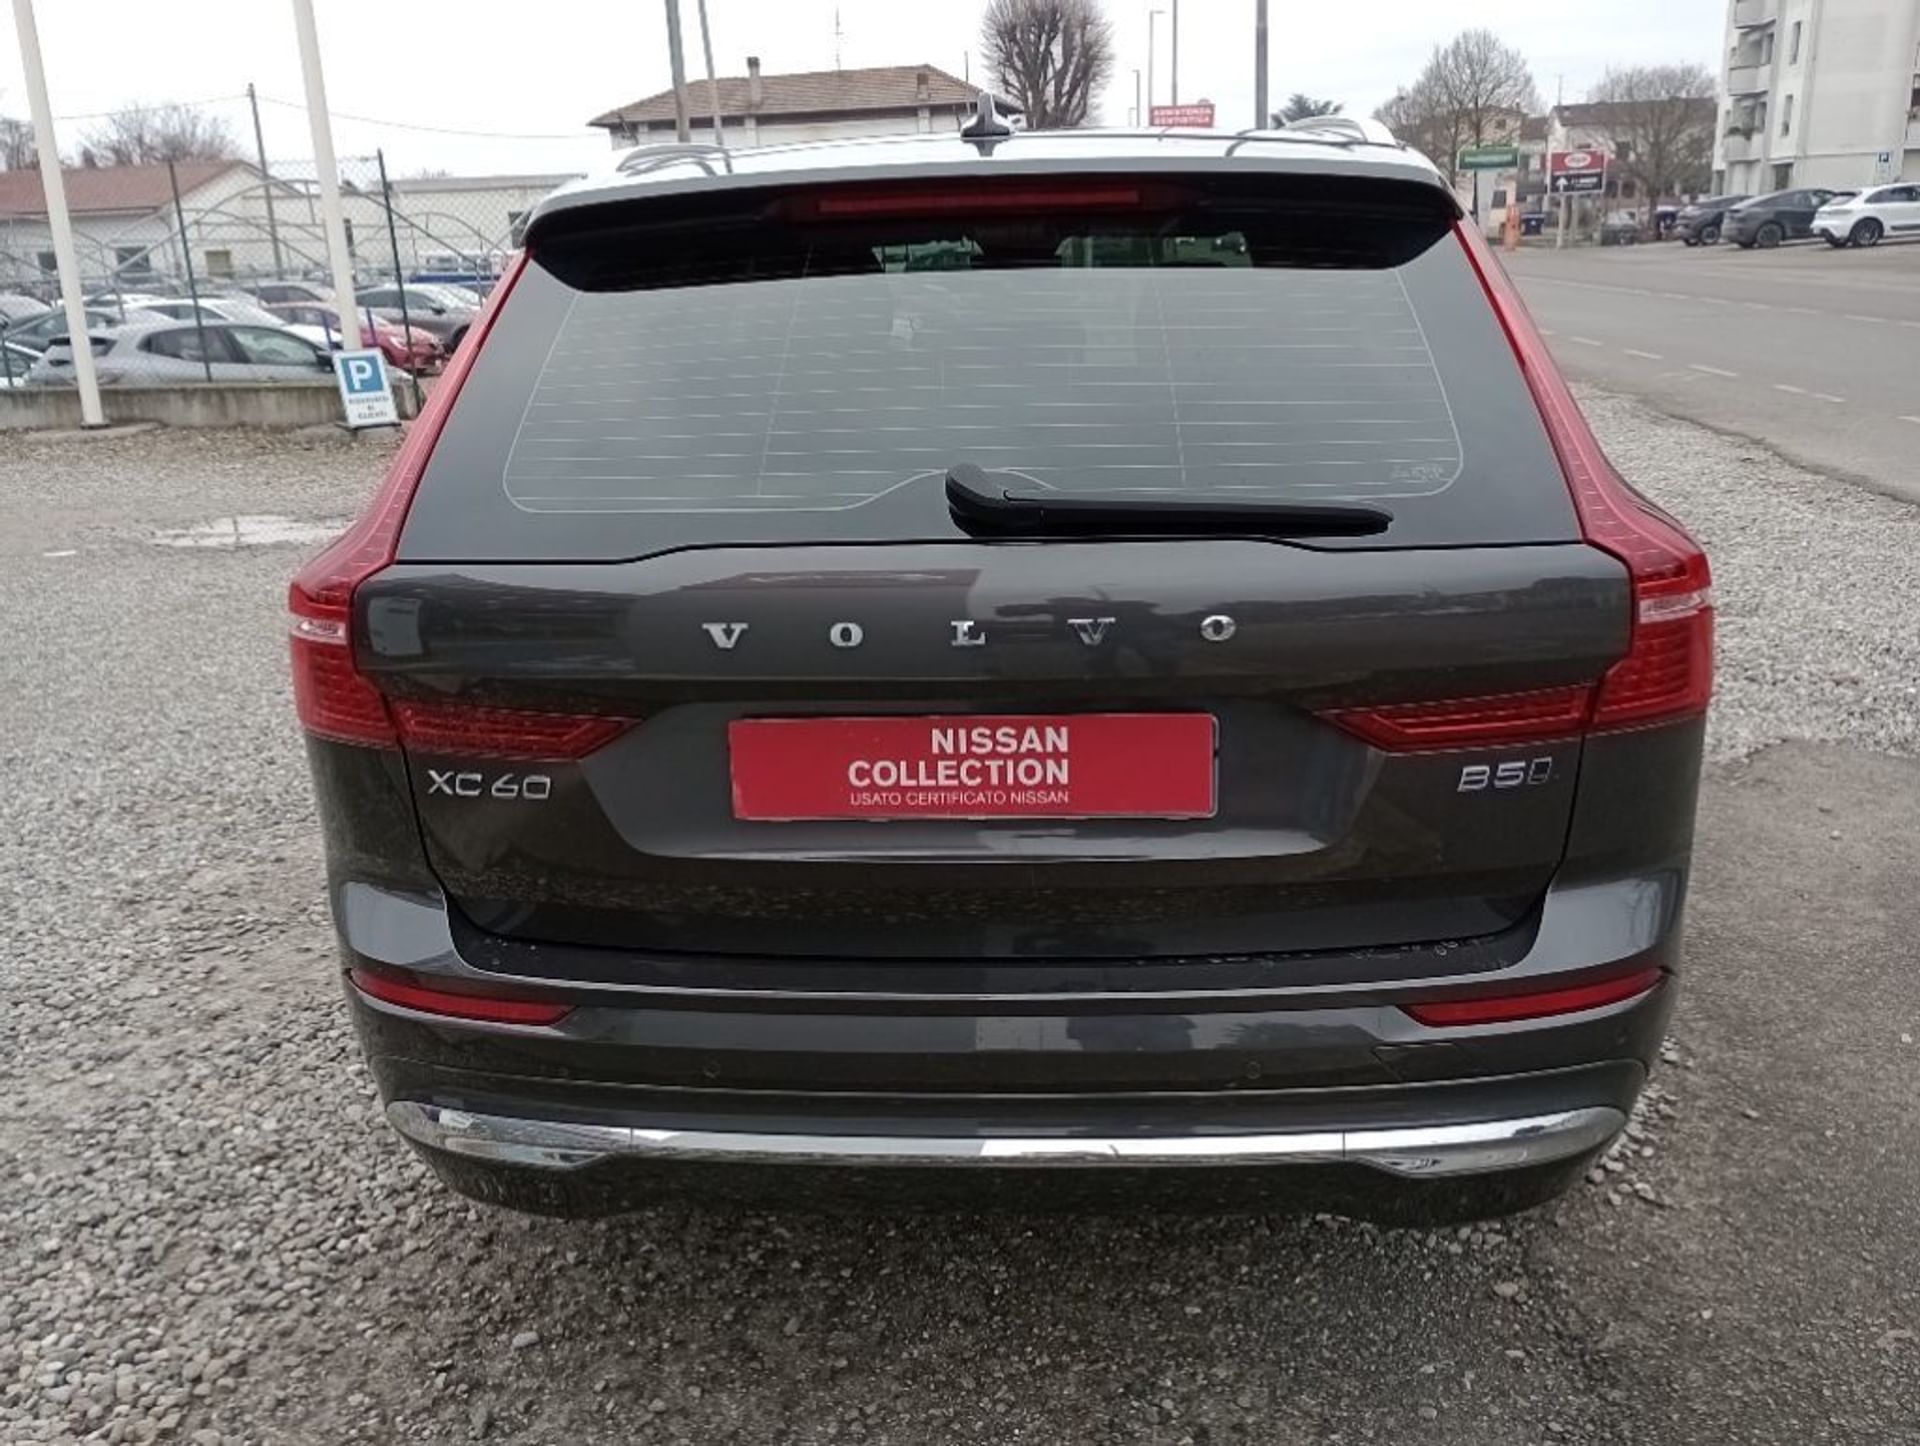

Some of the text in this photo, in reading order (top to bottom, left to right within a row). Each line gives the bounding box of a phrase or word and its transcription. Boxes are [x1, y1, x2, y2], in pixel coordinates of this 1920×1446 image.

[348, 360, 373, 390] P
[702, 615, 1236, 649] VOLVO
[931, 726, 1069, 754] NISSAN
[848, 758, 1069, 787] COLLECTION
[850, 790, 1069, 806] USATO CERTIFICATO NISSAN
